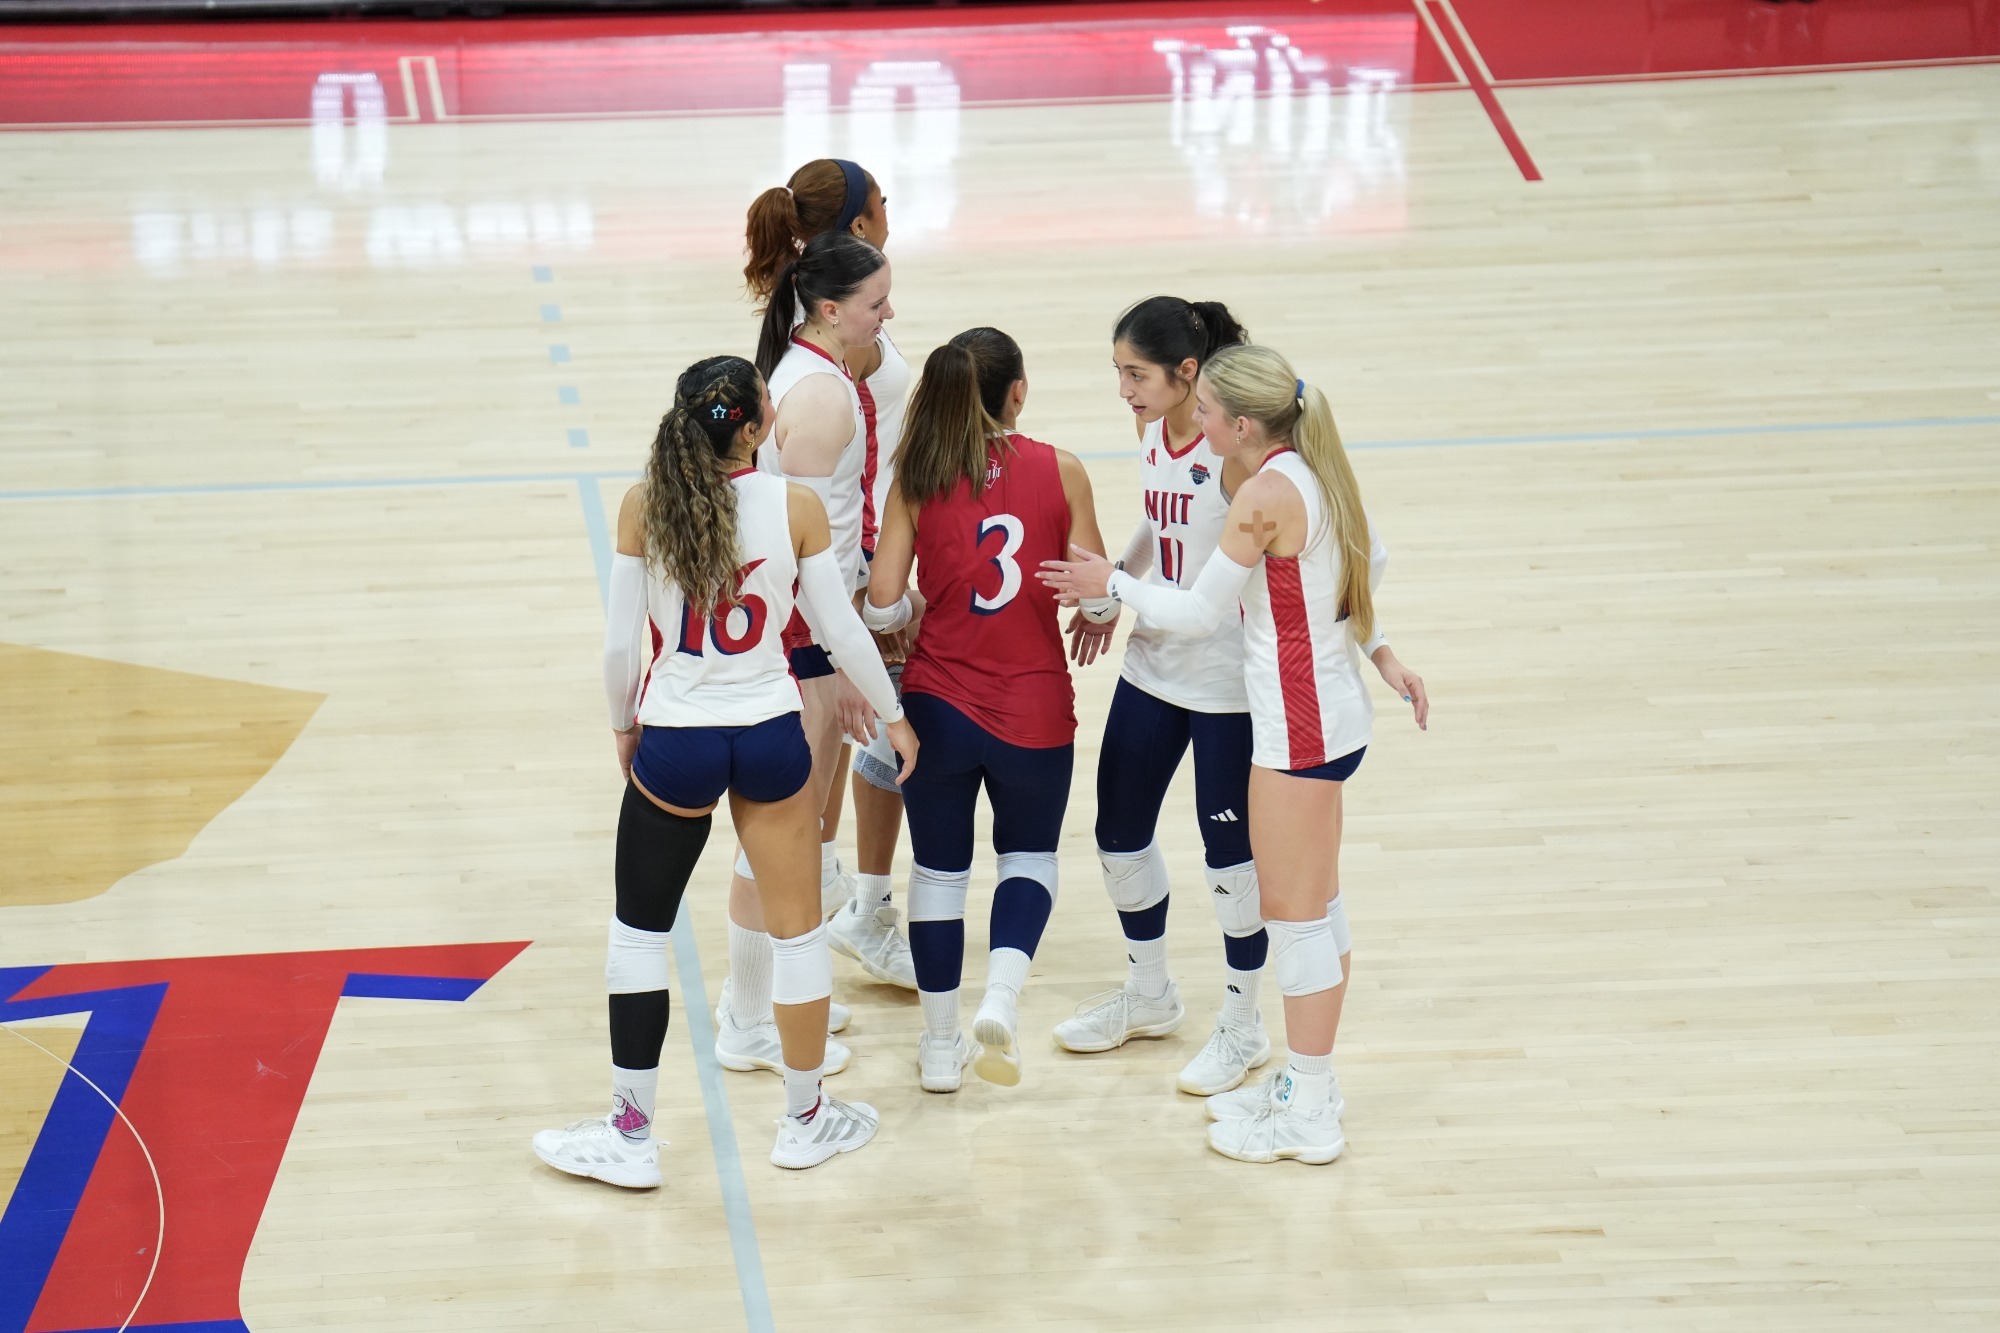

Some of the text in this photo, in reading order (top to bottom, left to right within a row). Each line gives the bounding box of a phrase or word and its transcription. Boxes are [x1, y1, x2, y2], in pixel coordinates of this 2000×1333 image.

[1145, 489, 1194, 531] NJIT
[676, 558, 768, 658] 16
[969, 513, 1025, 616] 3
